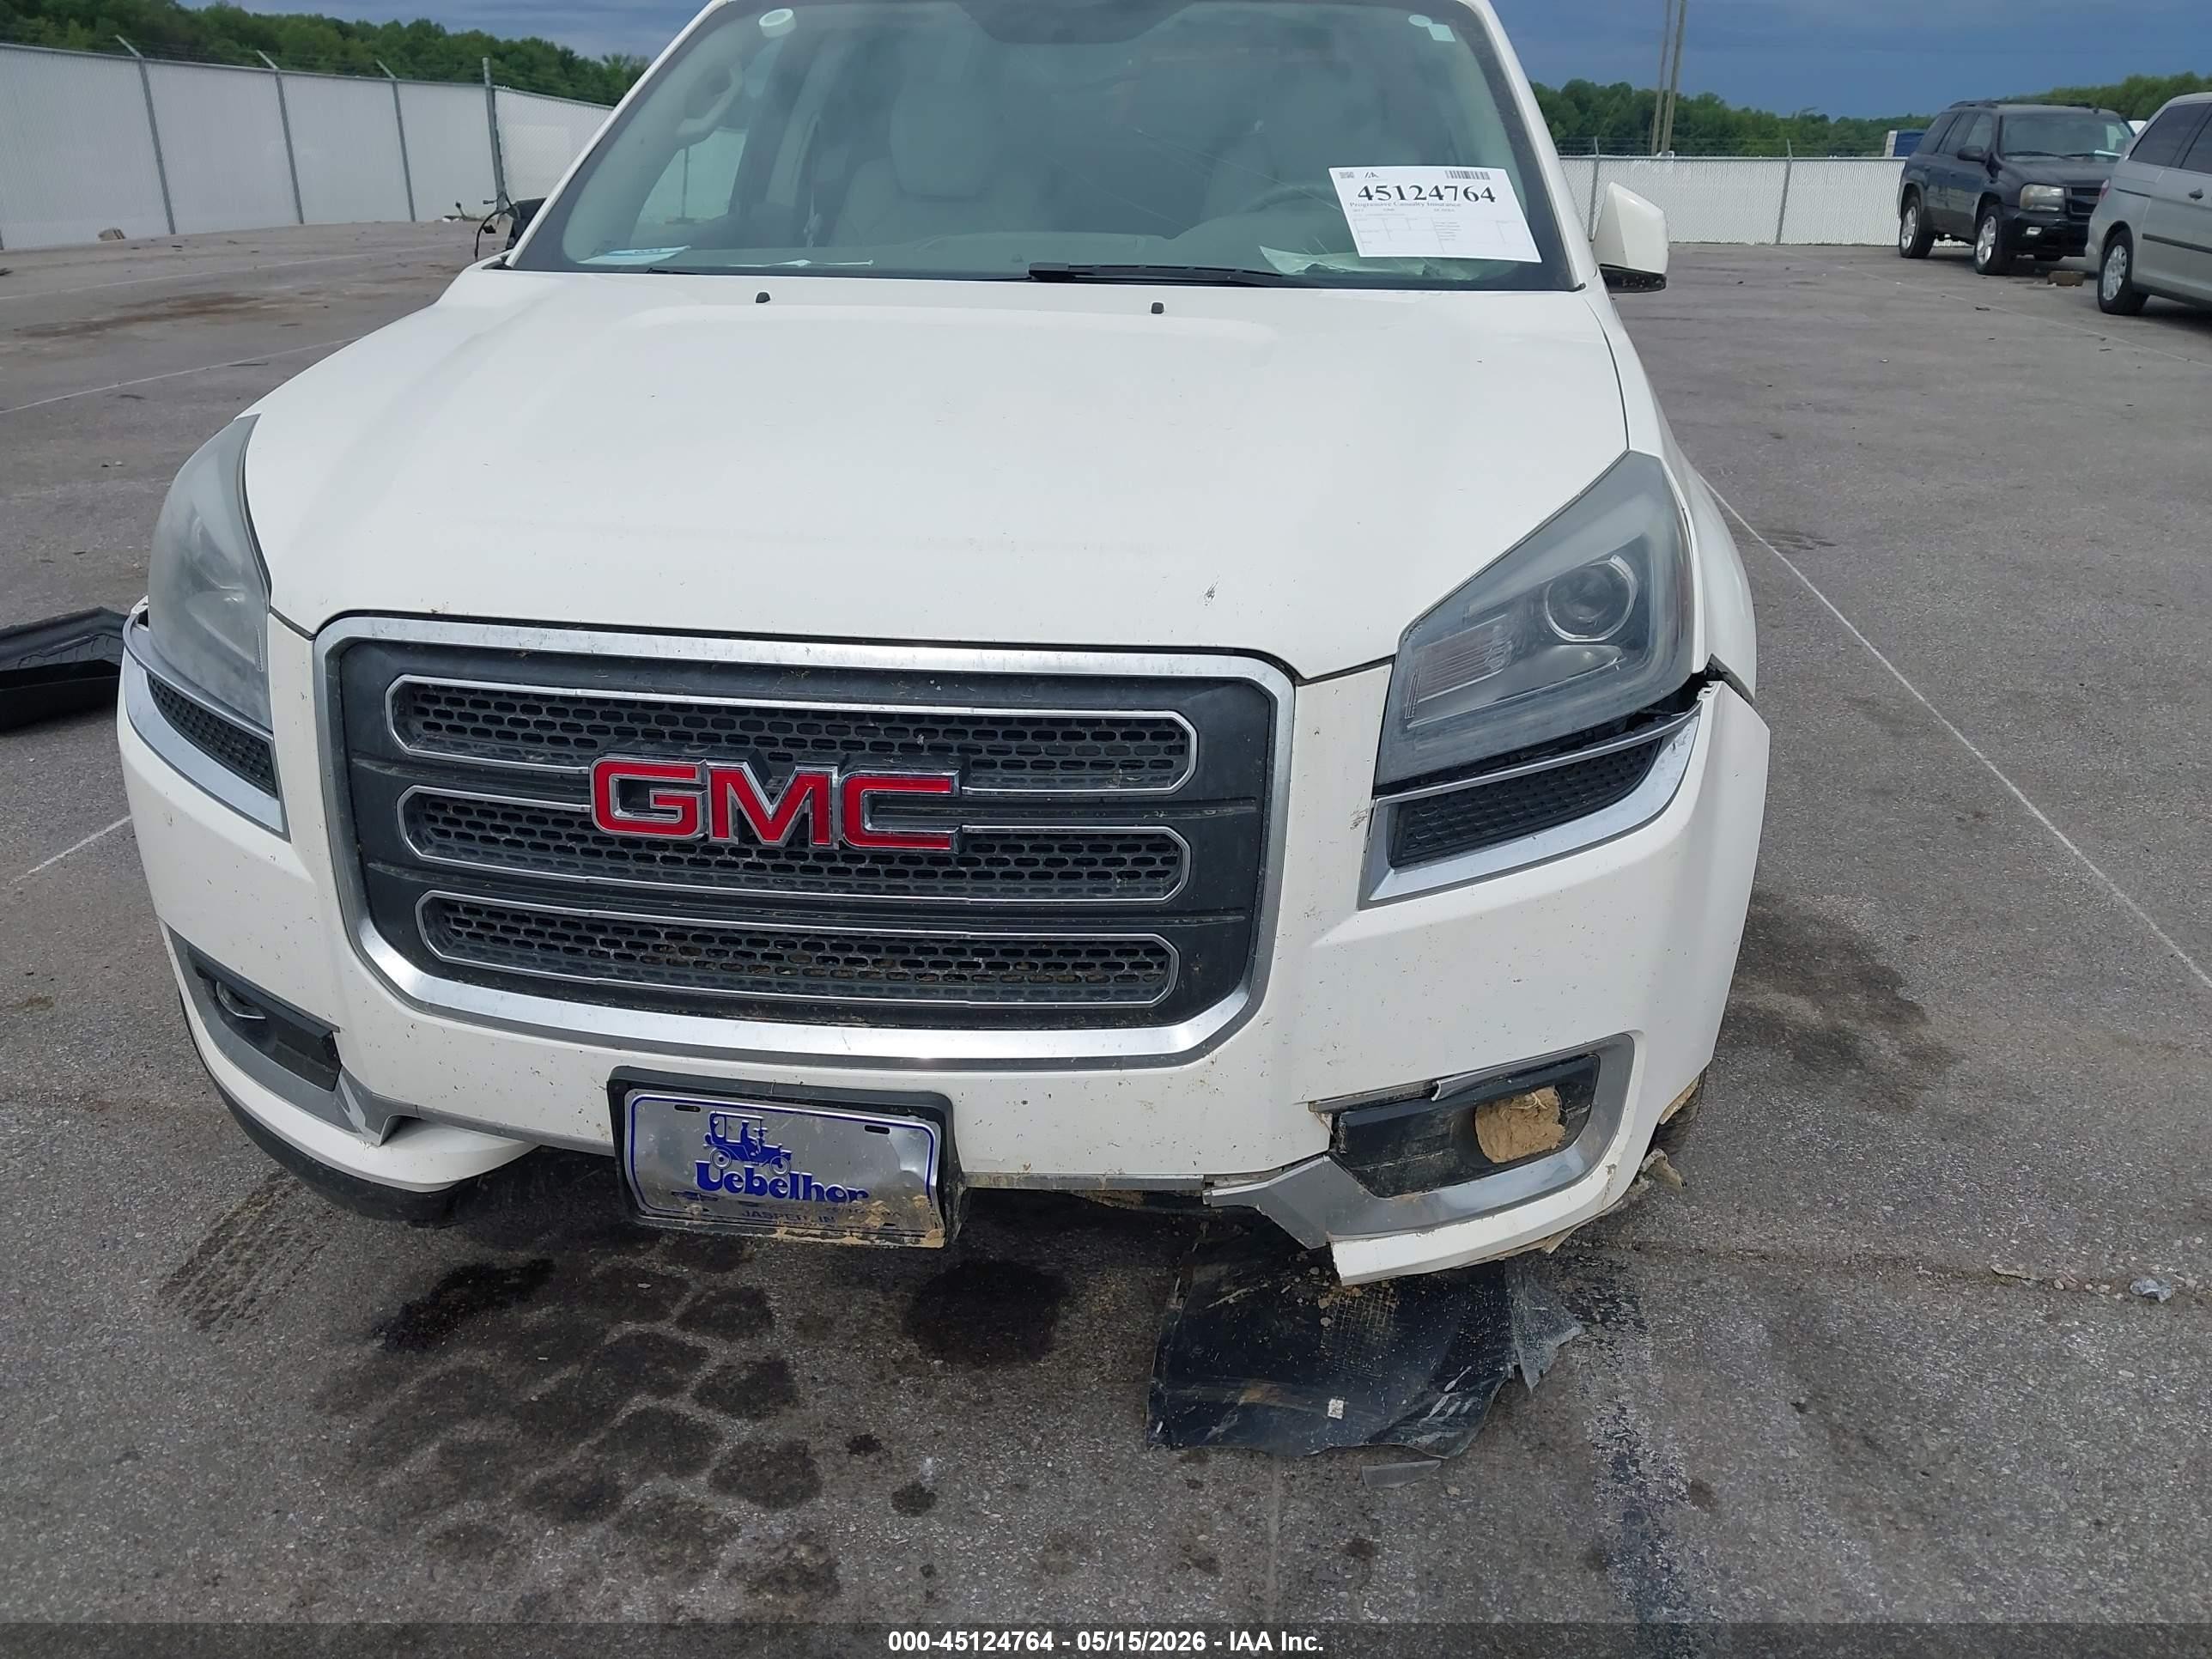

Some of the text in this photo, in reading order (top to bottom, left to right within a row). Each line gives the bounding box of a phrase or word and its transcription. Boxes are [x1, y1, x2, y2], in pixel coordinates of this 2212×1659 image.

[1358, 185, 1496, 203] 45124764
[590, 758, 959, 849] GMC
[696, 1160, 869, 1203] Uebelhor
